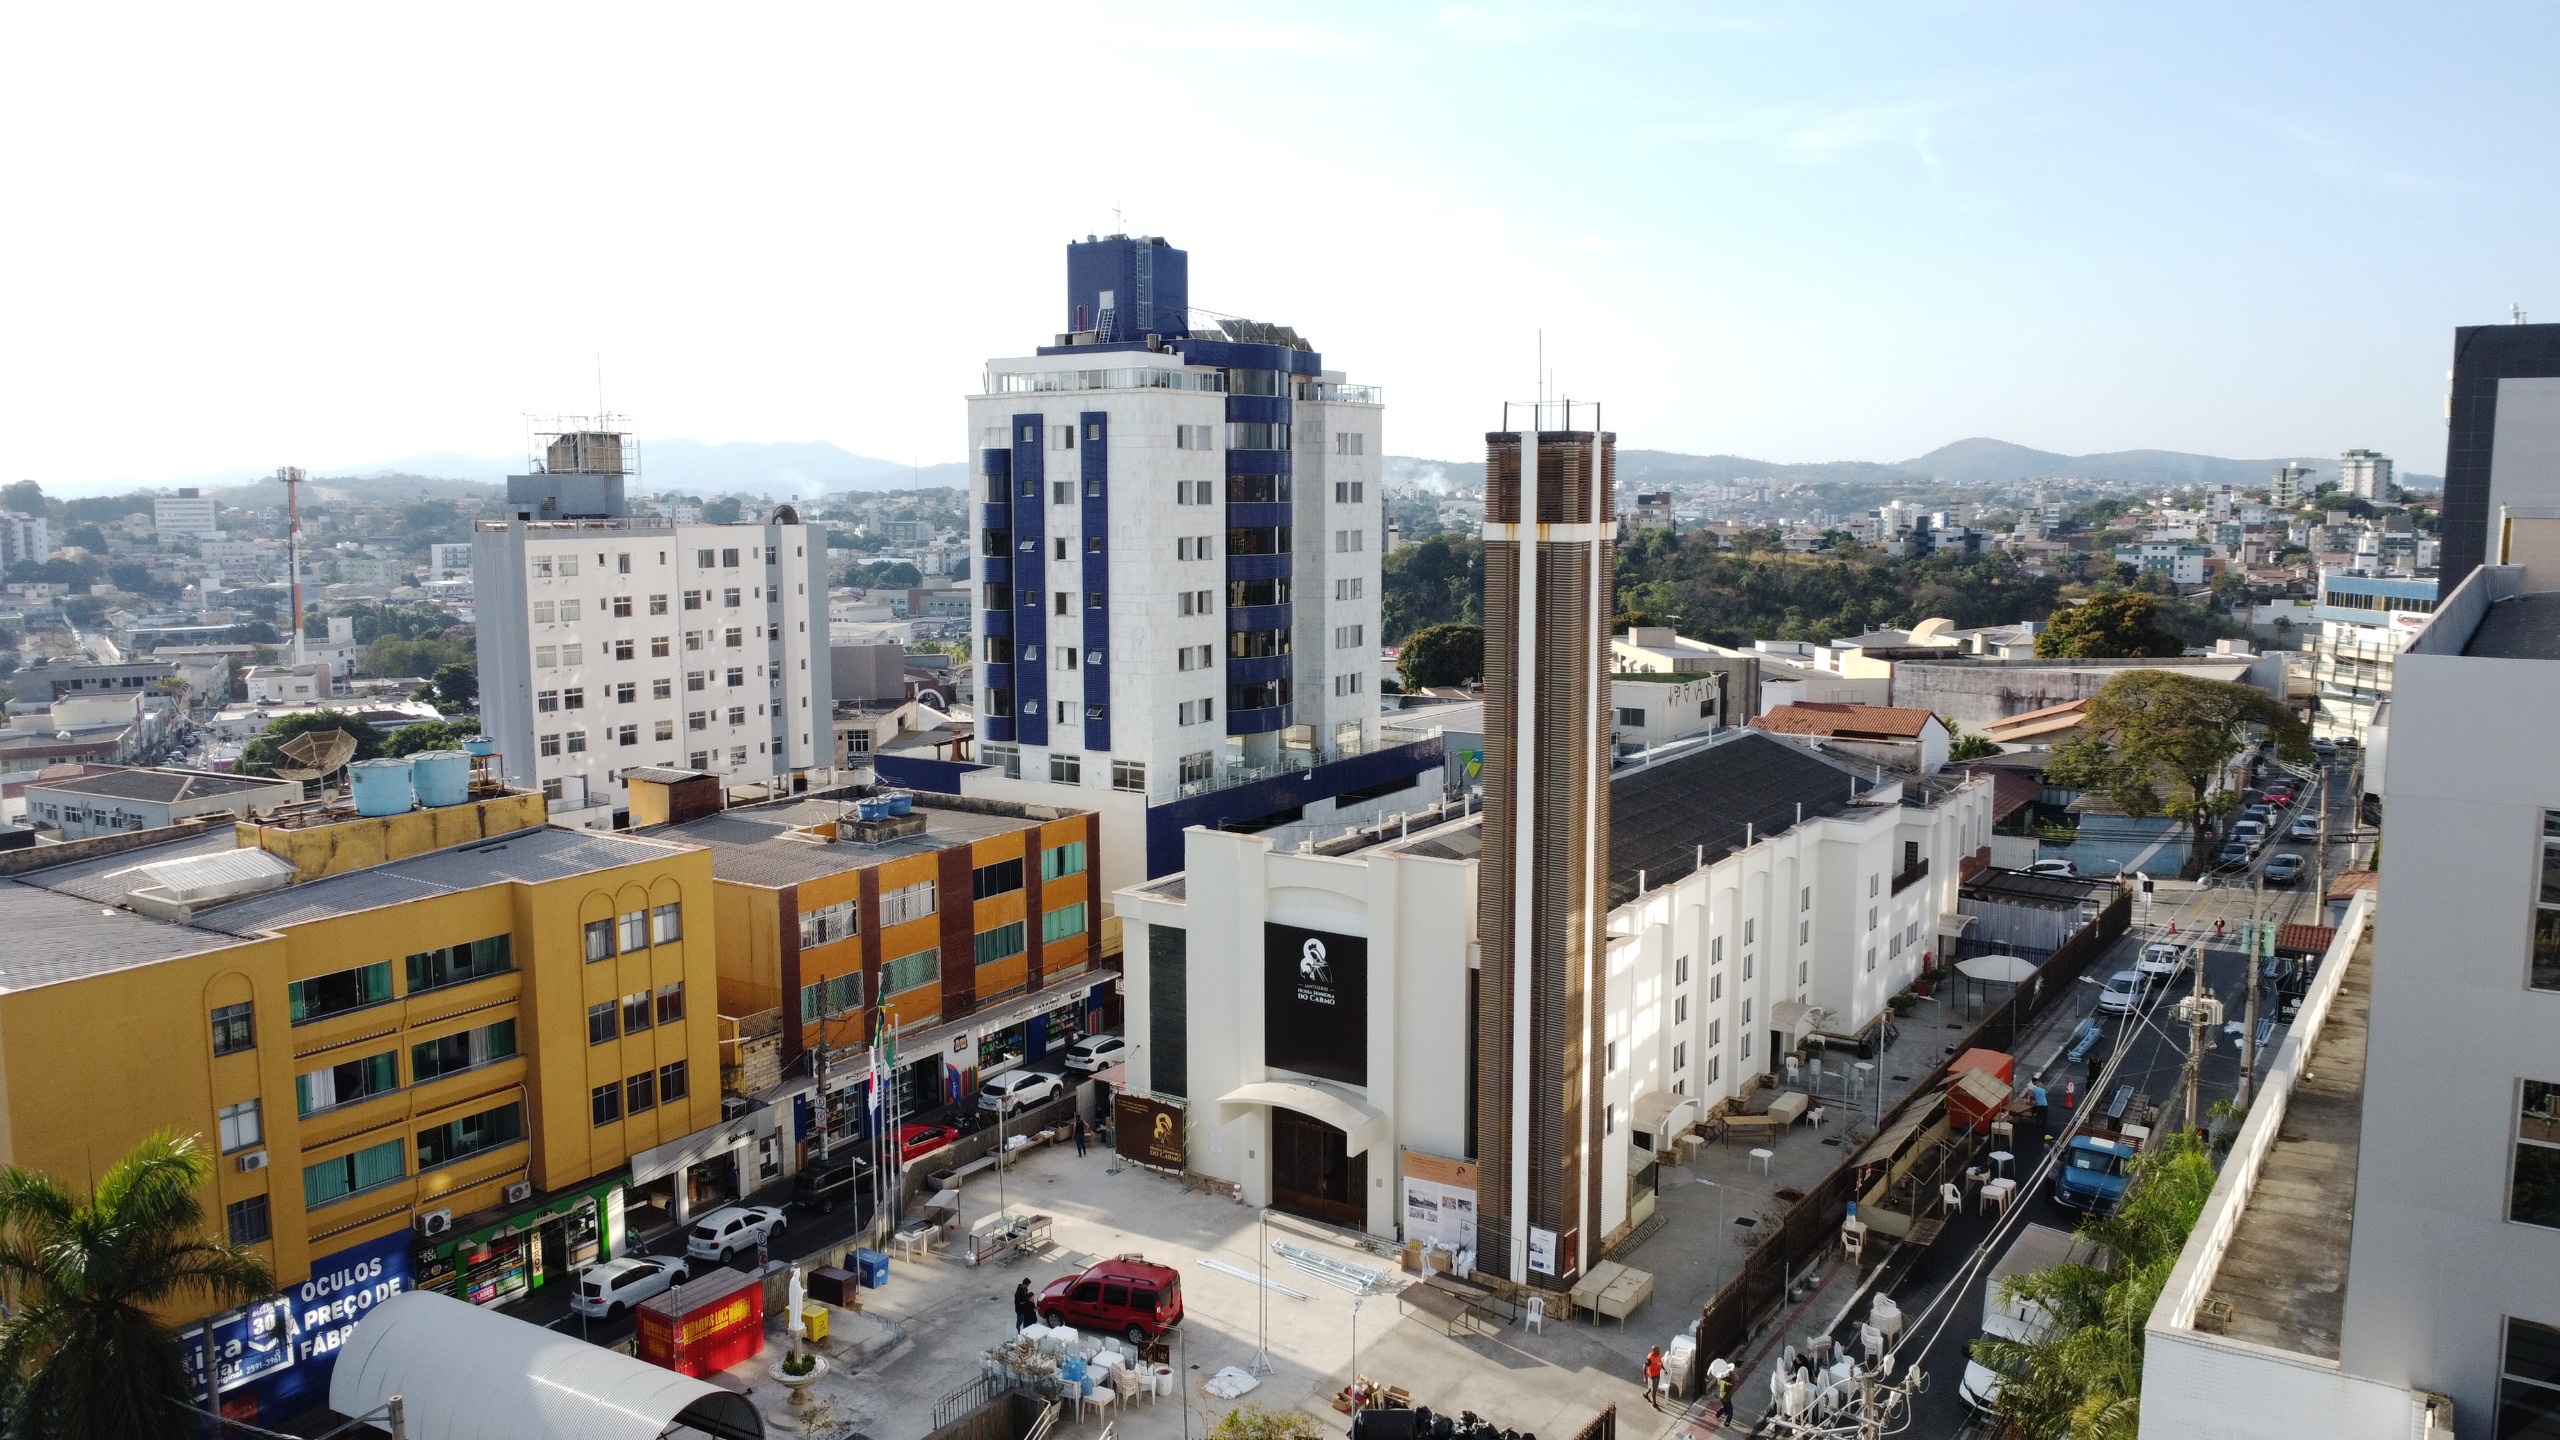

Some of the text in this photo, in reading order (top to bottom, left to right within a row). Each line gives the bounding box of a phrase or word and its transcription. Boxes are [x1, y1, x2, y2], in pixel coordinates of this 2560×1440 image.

[1310, 995, 1335, 1005] CARMO
[2281, 1005, 2298, 1015] SANT
[728, 1129, 756, 1146] Saborear
[1160, 1151, 1182, 1163] CARMO
[532, 1233, 543, 1273] XEROX
[304, 1289, 372, 1332] PREÇO
[376, 1277, 402, 1302] DE
[253, 1313, 276, 1336] 30
[217, 1370, 243, 1385] riginal
